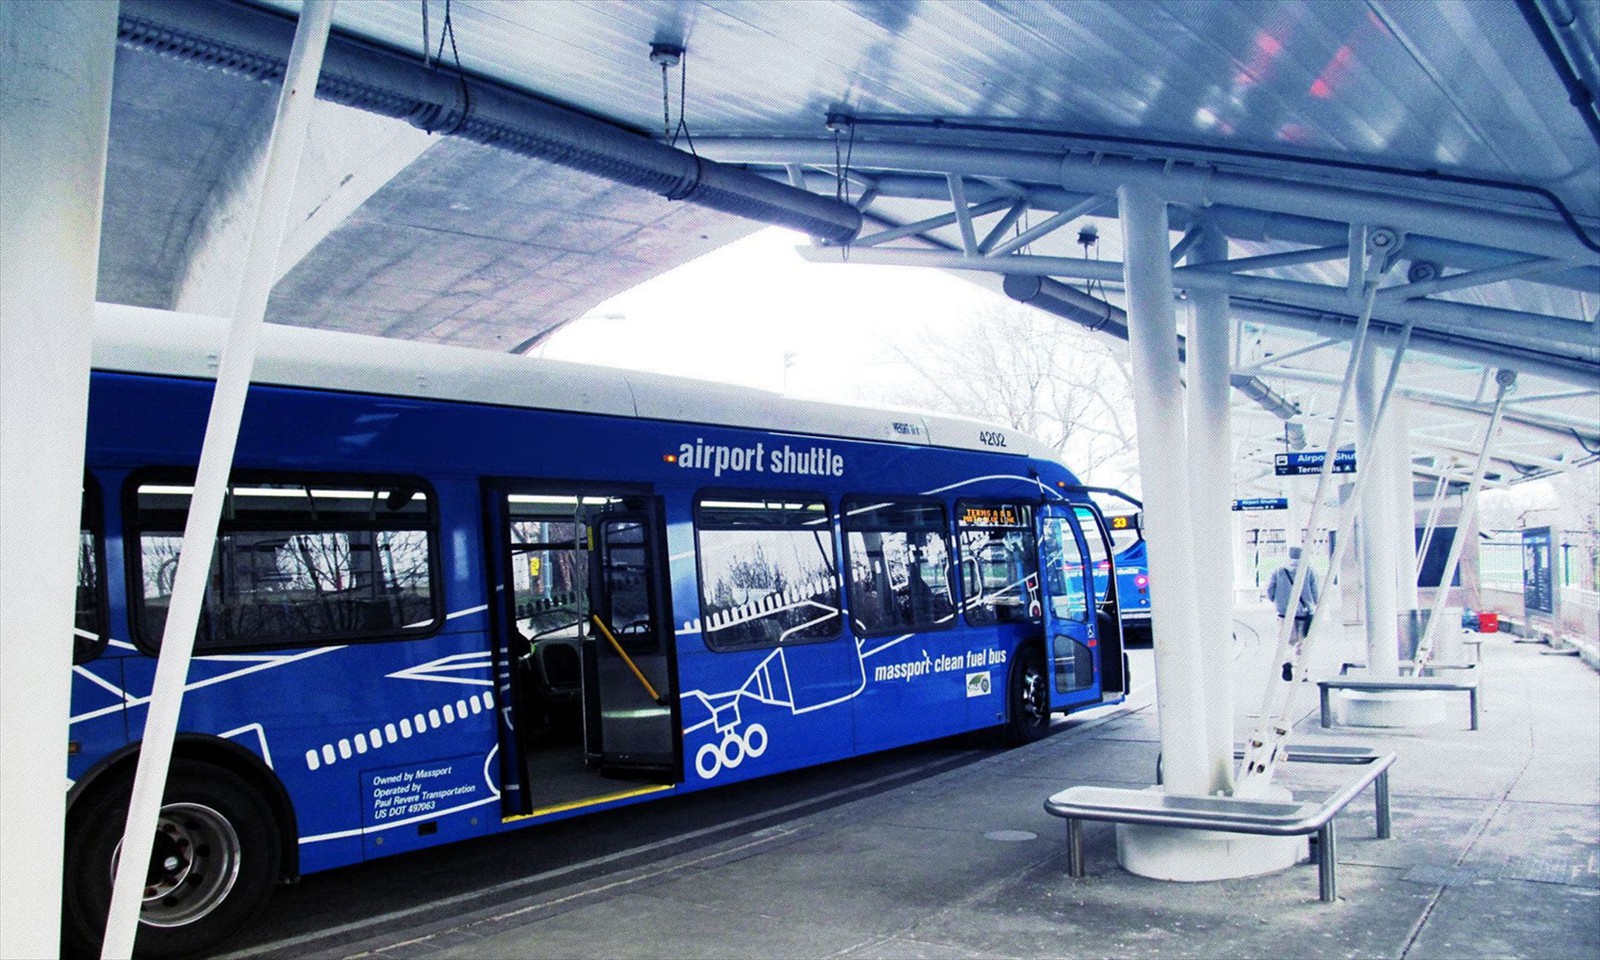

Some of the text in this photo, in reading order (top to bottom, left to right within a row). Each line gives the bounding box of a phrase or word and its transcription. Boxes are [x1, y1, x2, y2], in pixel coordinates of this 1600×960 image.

[979, 431, 1007, 448] 4202
[678, 437, 844, 477] airport shuttle
[1297, 454, 1327, 463] Airpo
[1297, 465, 1342, 474] Termils
[966, 508, 991, 517] TERMS
[1113, 518, 1127, 528] 33
[874, 648, 1007, 682] massport clean fuel bus
[373, 766, 452, 785] Owned by Massport
[373, 783, 422, 798] Operated by
[374, 784, 476, 808] Paul Revere Transportation
[374, 809, 387, 819] US
[388, 805, 405, 817] DOT
